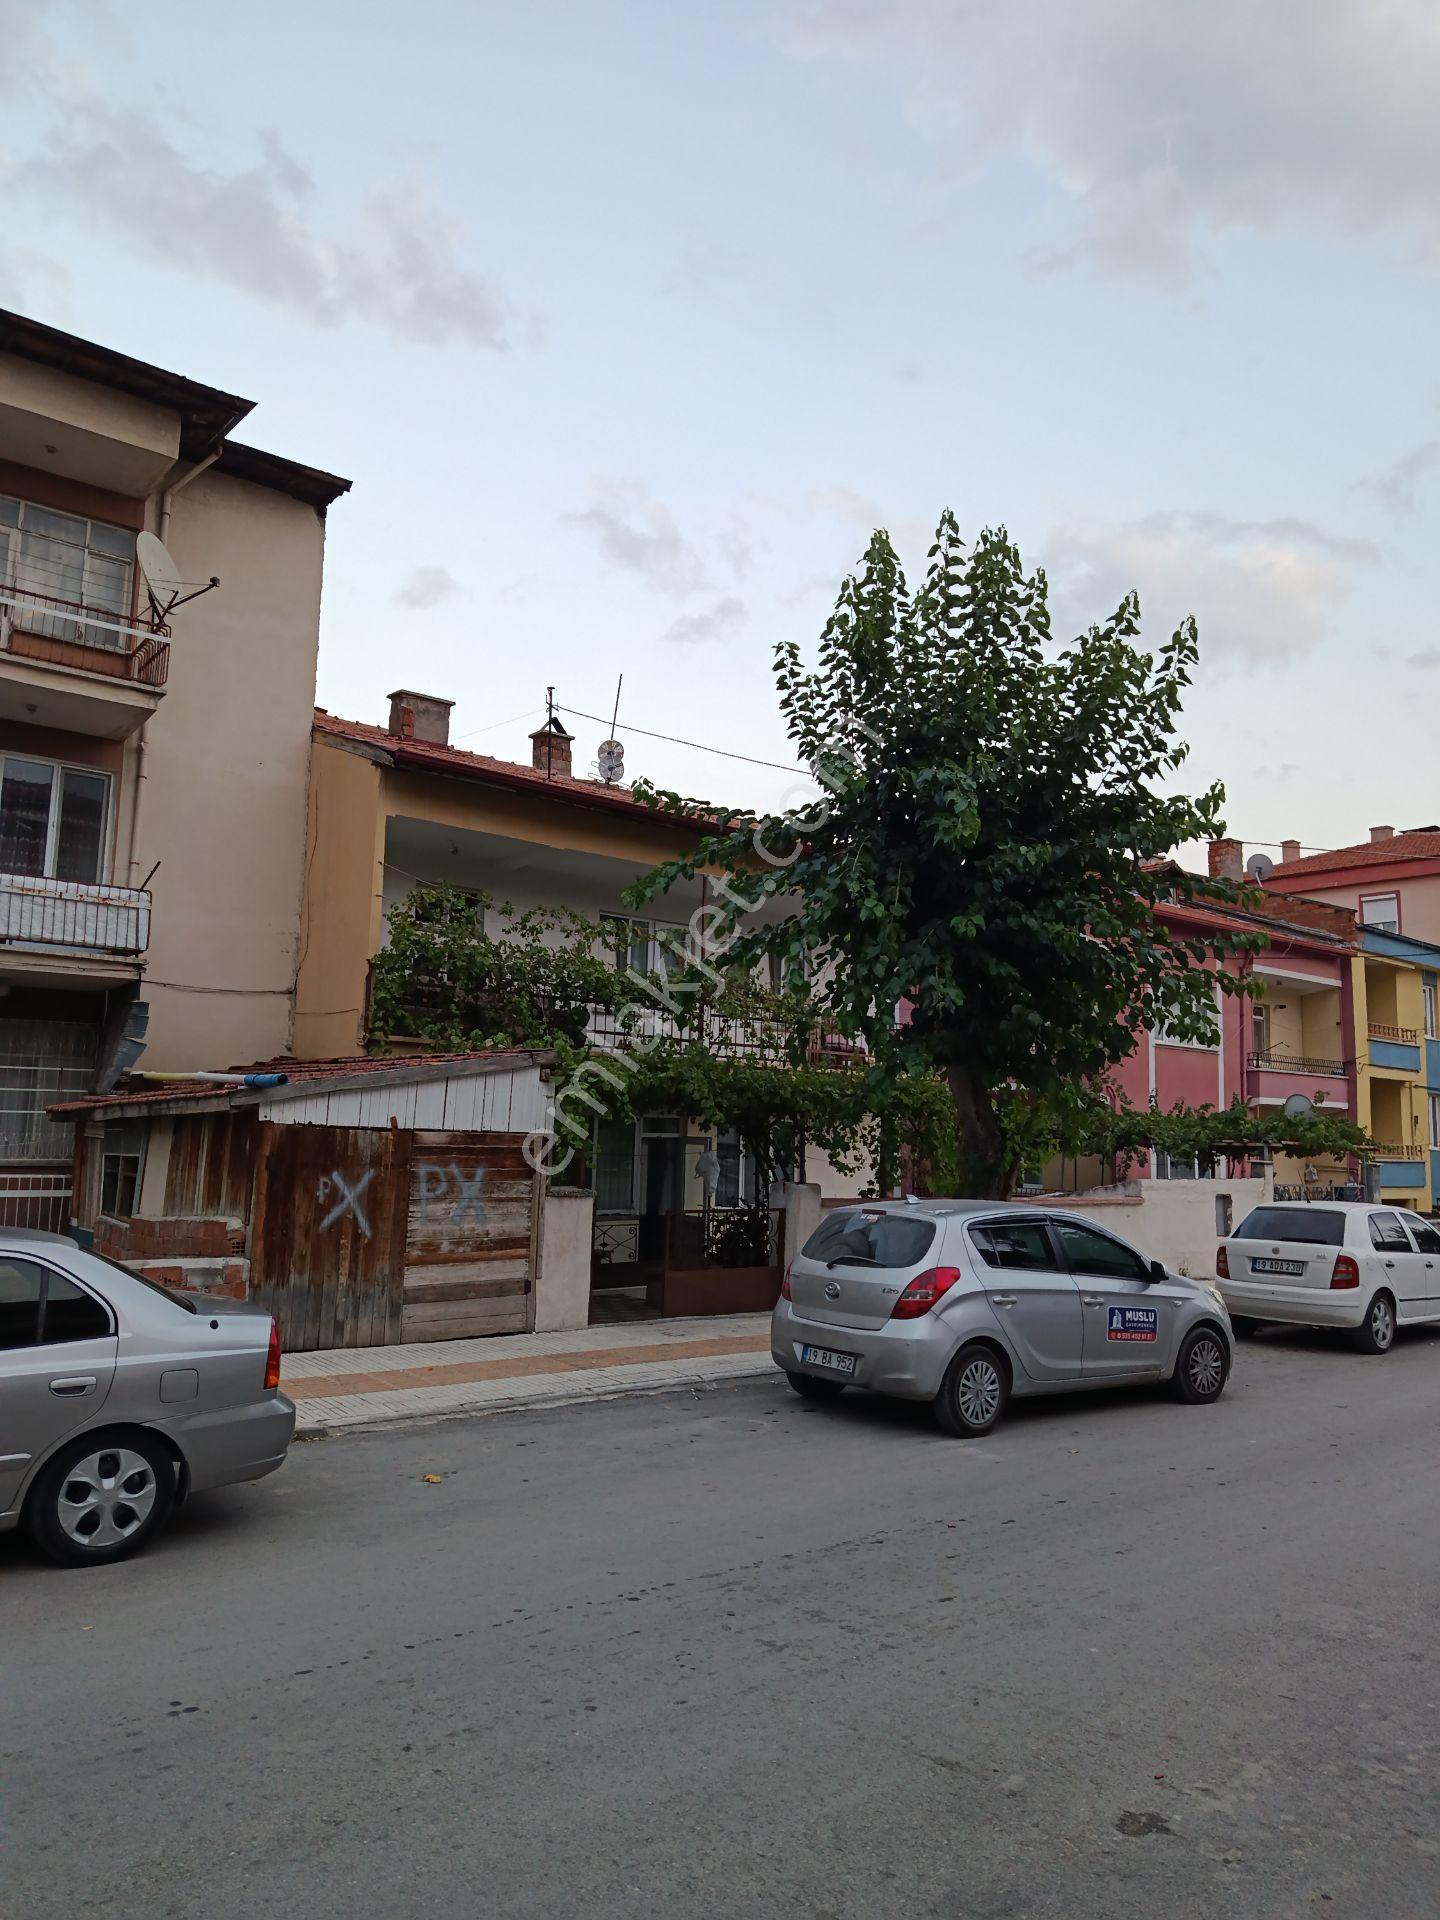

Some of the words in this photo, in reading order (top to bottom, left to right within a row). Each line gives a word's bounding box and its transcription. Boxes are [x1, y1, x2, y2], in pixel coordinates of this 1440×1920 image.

[416, 1162, 488, 1227] PX
[1257, 1260, 1267, 1269] 19
[1125, 1310, 1155, 1322] MUSLU
[807, 1348, 818, 1362] 19
[821, 1351, 832, 1366] BA
[836, 1355, 853, 1371] 952
